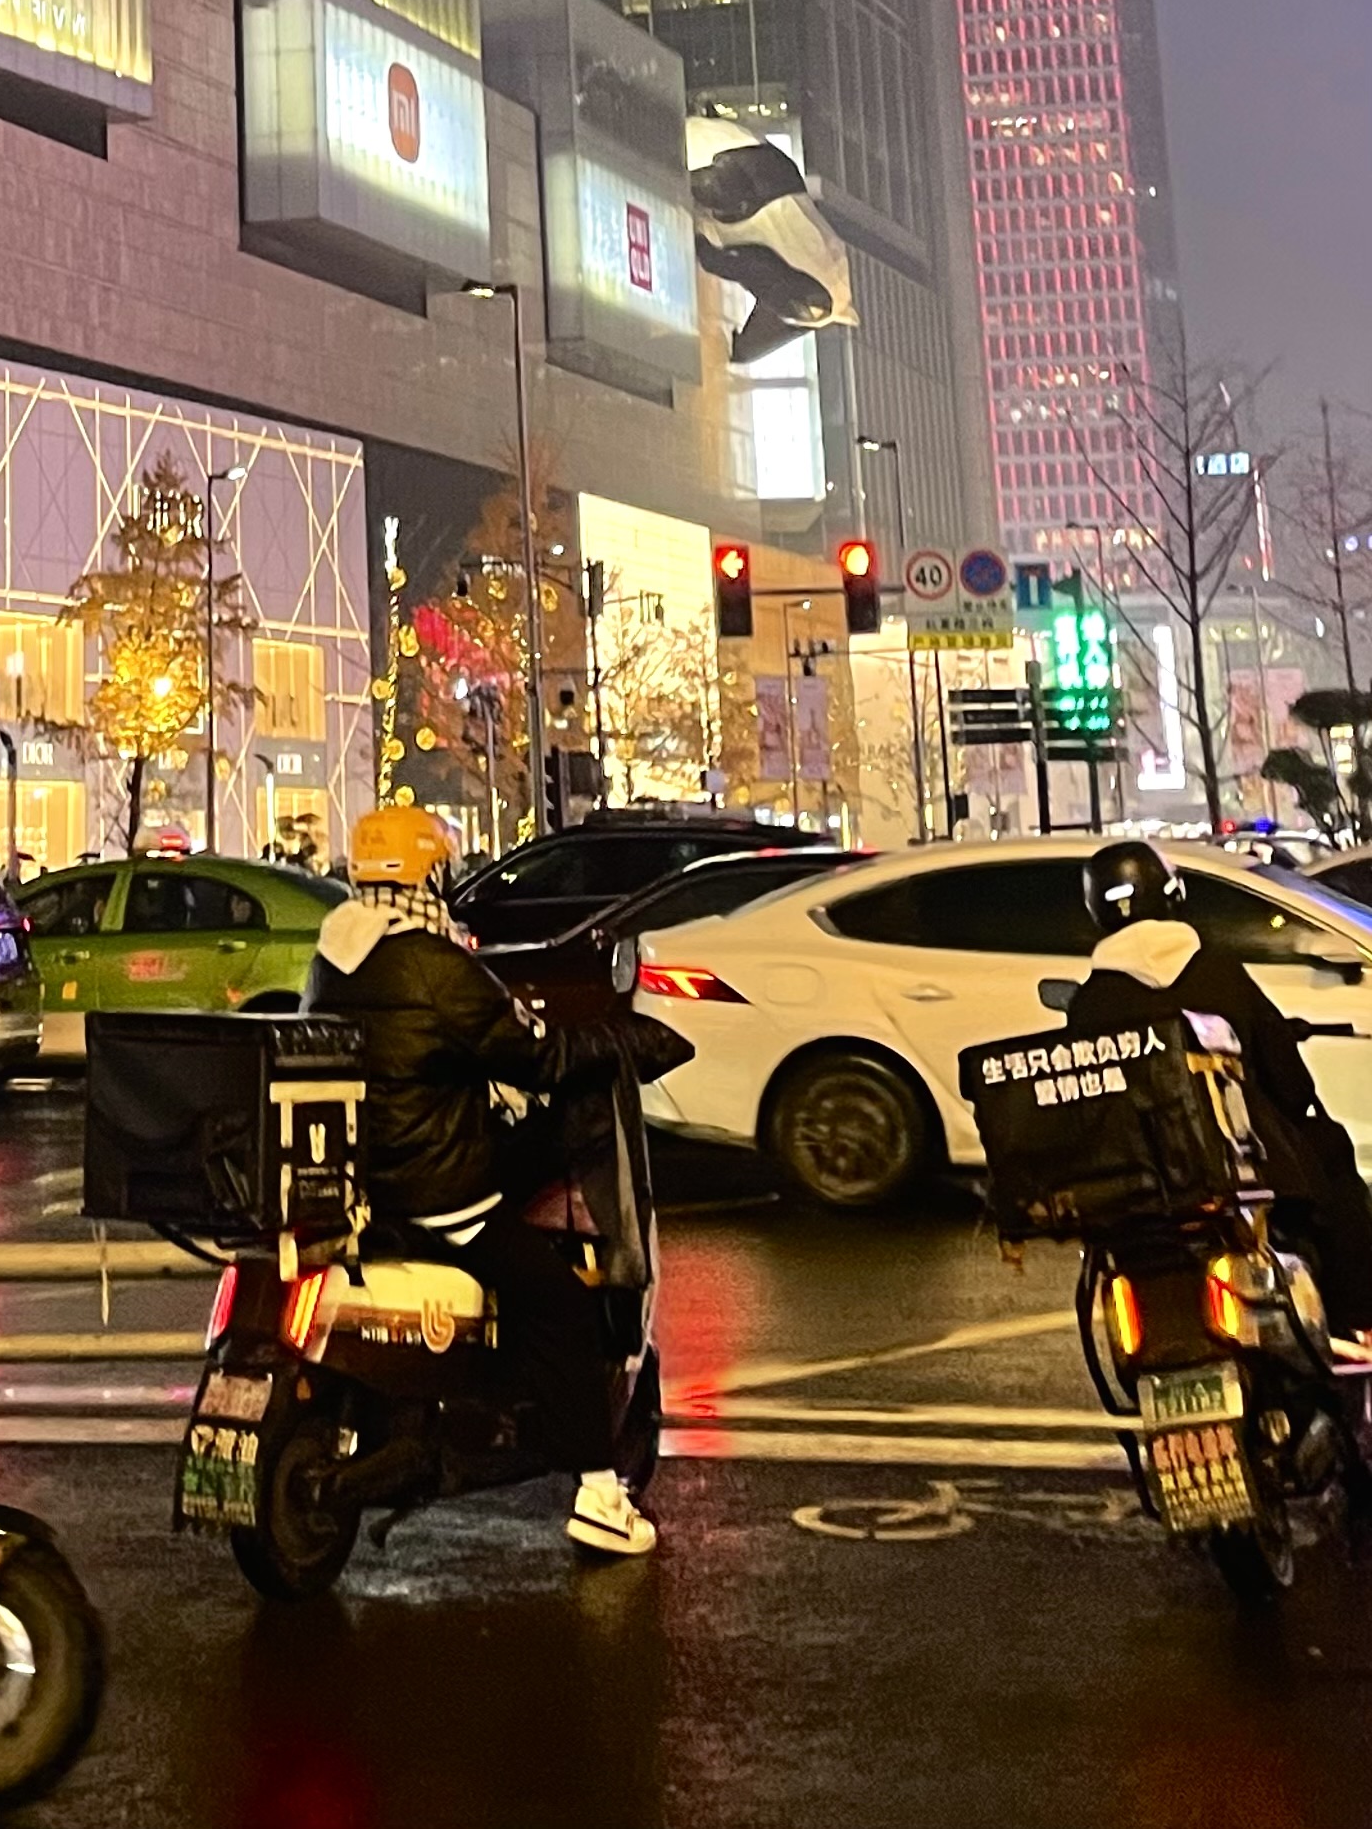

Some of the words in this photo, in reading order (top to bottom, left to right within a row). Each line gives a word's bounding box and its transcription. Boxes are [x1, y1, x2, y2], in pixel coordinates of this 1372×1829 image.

[915, 564, 942, 587] 40
[982, 1026, 1166, 1085] 生活只会欺负穷人
